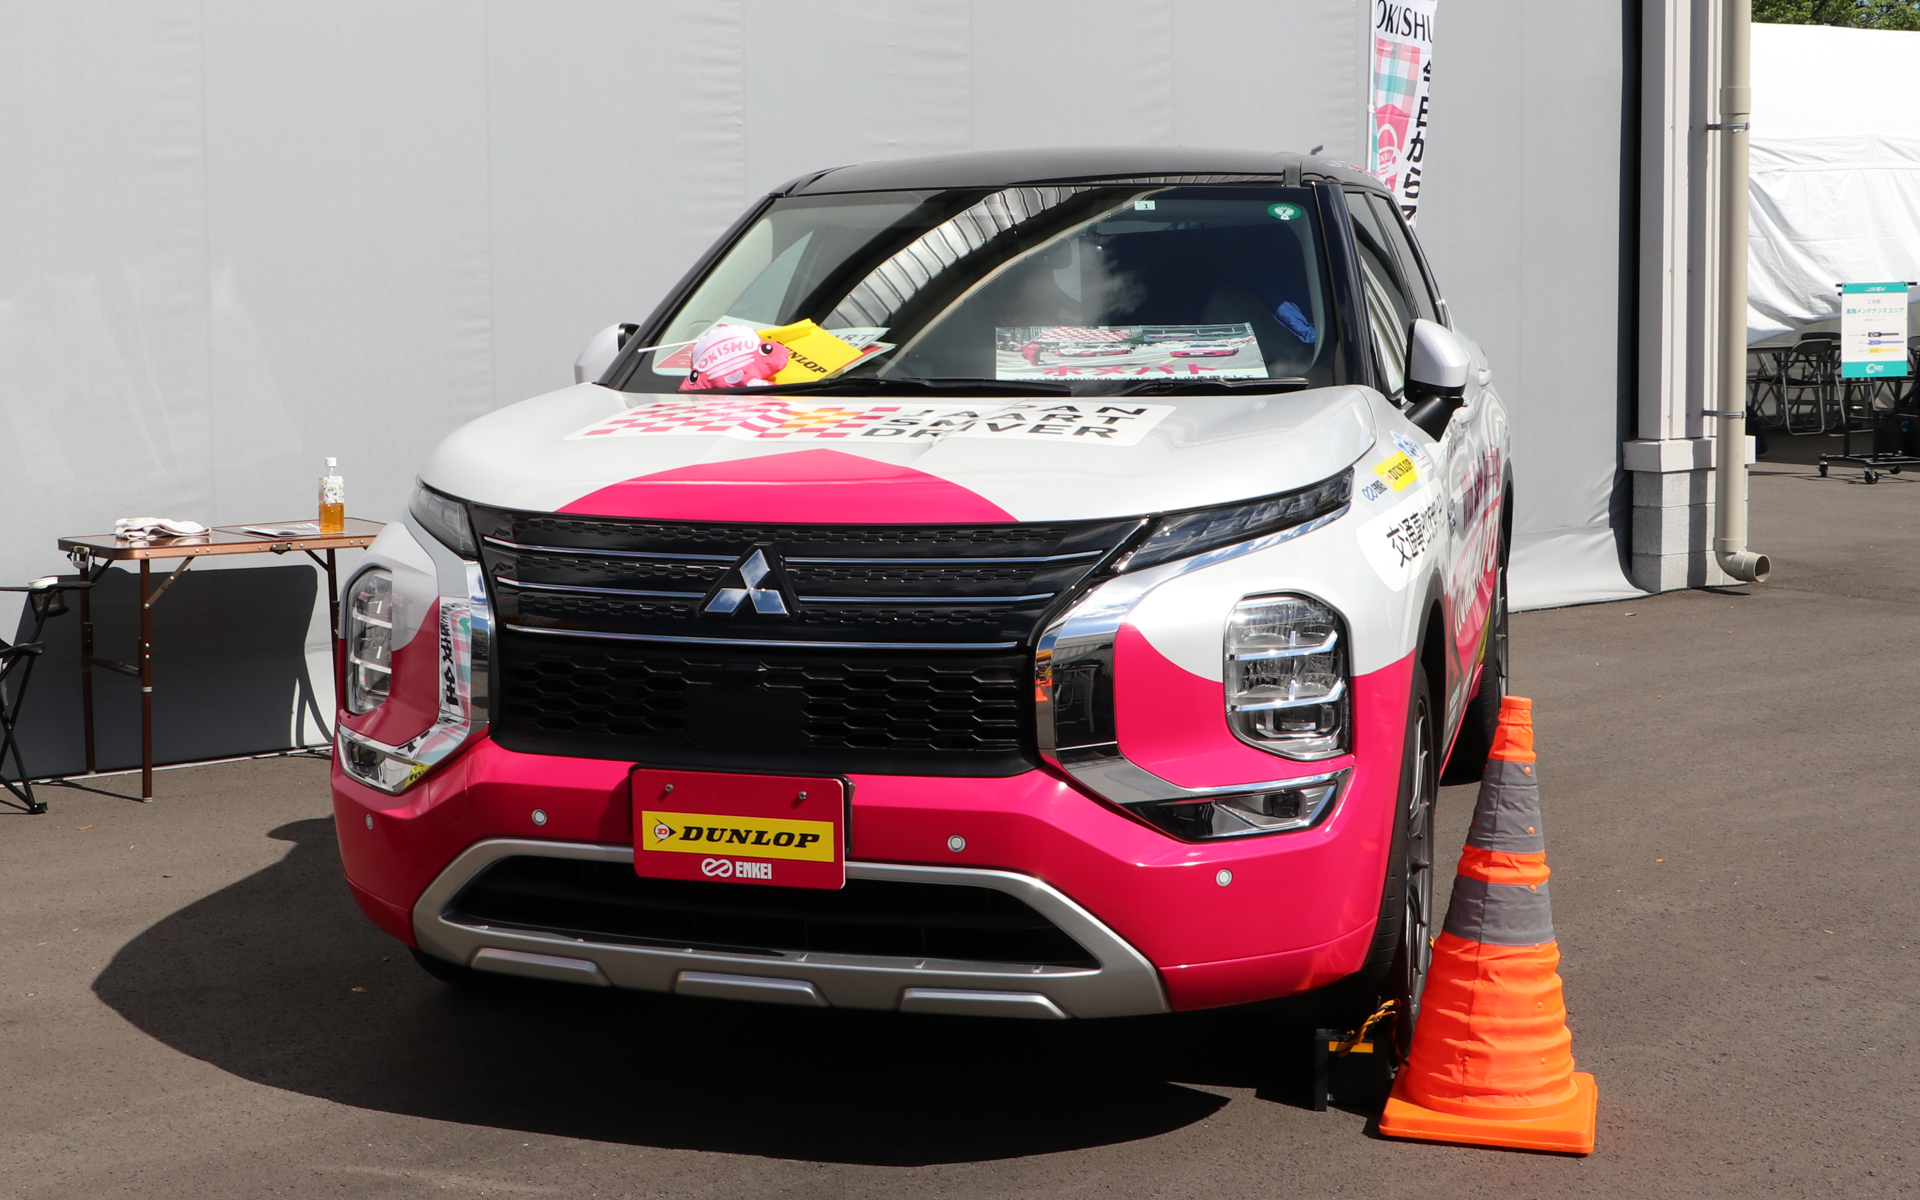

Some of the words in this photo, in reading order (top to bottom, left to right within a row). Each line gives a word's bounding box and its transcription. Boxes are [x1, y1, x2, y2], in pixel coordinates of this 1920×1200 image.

[699, 340, 755, 369] OKISHU
[1043, 363, 1217, 377] ホメパト
[861, 422, 1118, 440] DRIVER
[679, 825, 820, 848] DUNLOP
[735, 861, 772, 880] ENKEI
